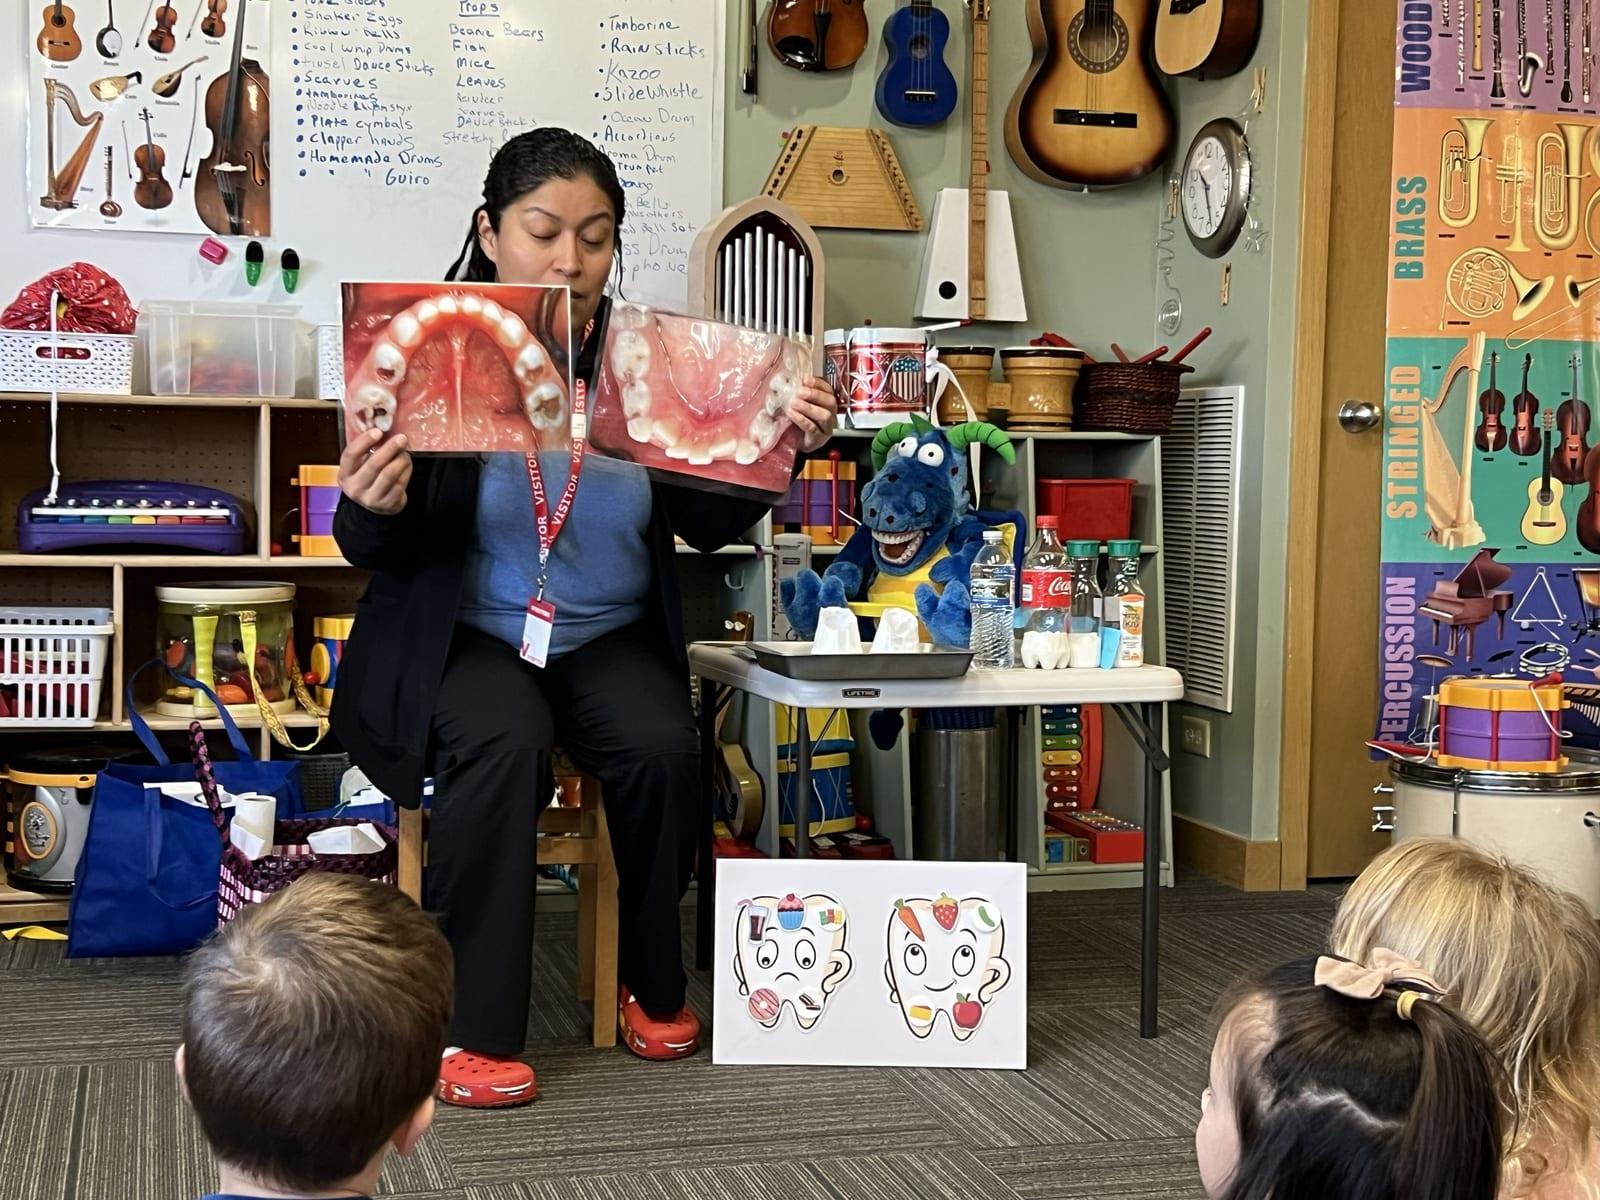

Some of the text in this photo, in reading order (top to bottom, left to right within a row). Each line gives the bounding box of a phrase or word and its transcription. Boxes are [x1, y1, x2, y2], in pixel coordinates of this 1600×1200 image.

[366, 10, 404, 28] Eggs
[503, 22, 544, 41] Bears
[453, 40, 486, 52] Fish
[1401, 0, 1432, 93] WOOD
[456, 57, 495, 70] Mice
[605, 59, 661, 84] Kazoo
[304, 70, 378, 89] Scarves
[658, 107, 695, 126] Drum
[310, 149, 443, 168] Homemade Drums
[385, 168, 430, 186] Guiro
[1393, 175, 1428, 280] BRASS
[574, 378, 586, 414] ISITO
[1386, 364, 1422, 520] STRINGED
[551, 474, 578, 526] VISITOR
